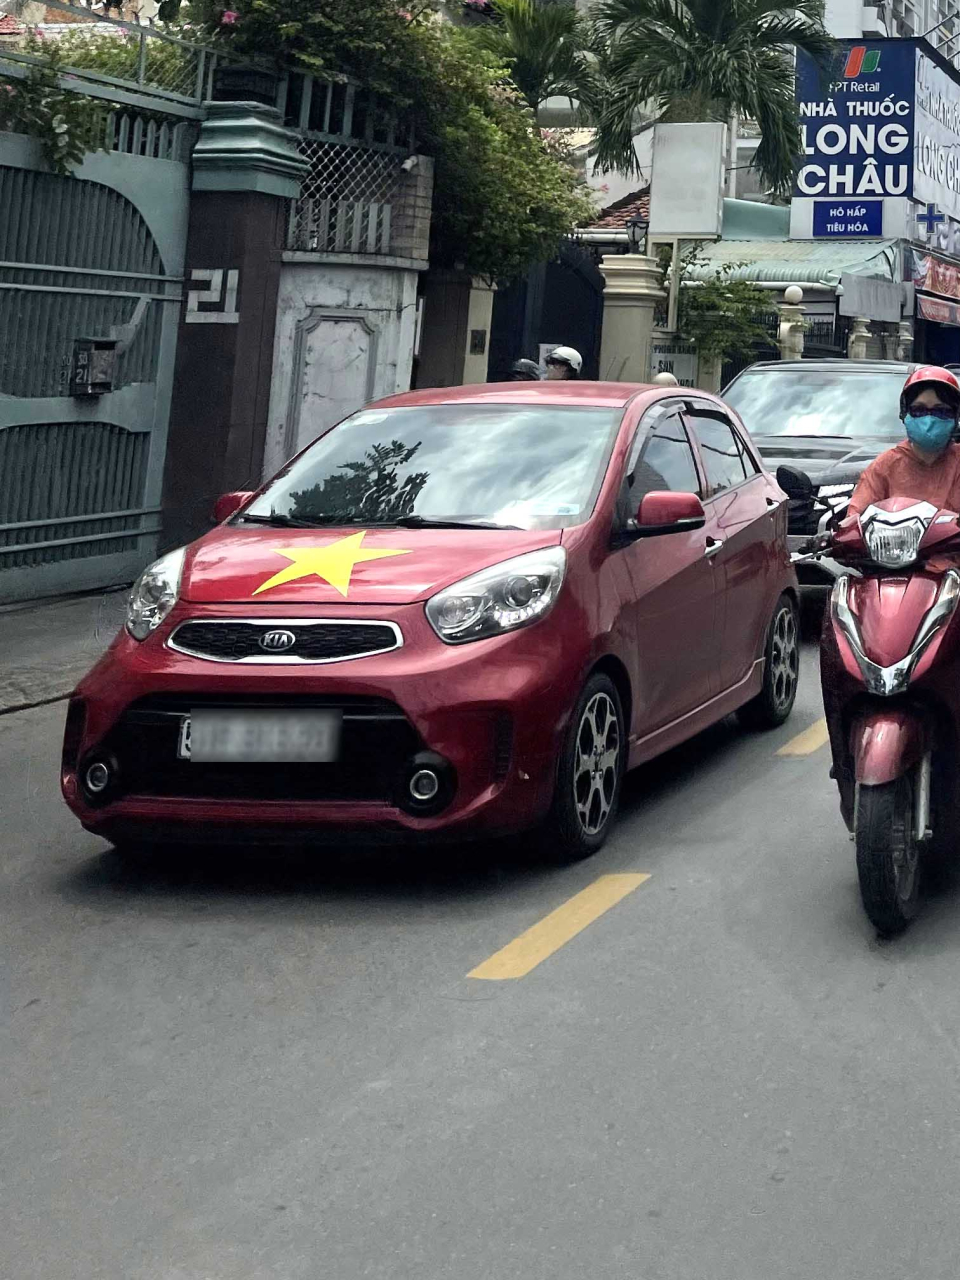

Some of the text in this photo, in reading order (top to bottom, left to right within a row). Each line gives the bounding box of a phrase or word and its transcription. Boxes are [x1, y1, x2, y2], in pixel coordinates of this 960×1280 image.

[850, 81, 880, 93] Retail
[800, 98, 837, 117] NHÀ
[846, 93, 910, 117] THUỐC
[800, 123, 909, 155] LONG
[916, 131, 945, 185] LONG
[797, 157, 908, 195] CHÂU
[846, 205, 867, 217] HẤP
[826, 221, 869, 232] TIÊU HÓA
[186, 268, 239, 324] 21
[76, 369, 88, 383] 21
[263, 633, 289, 647] KIA
